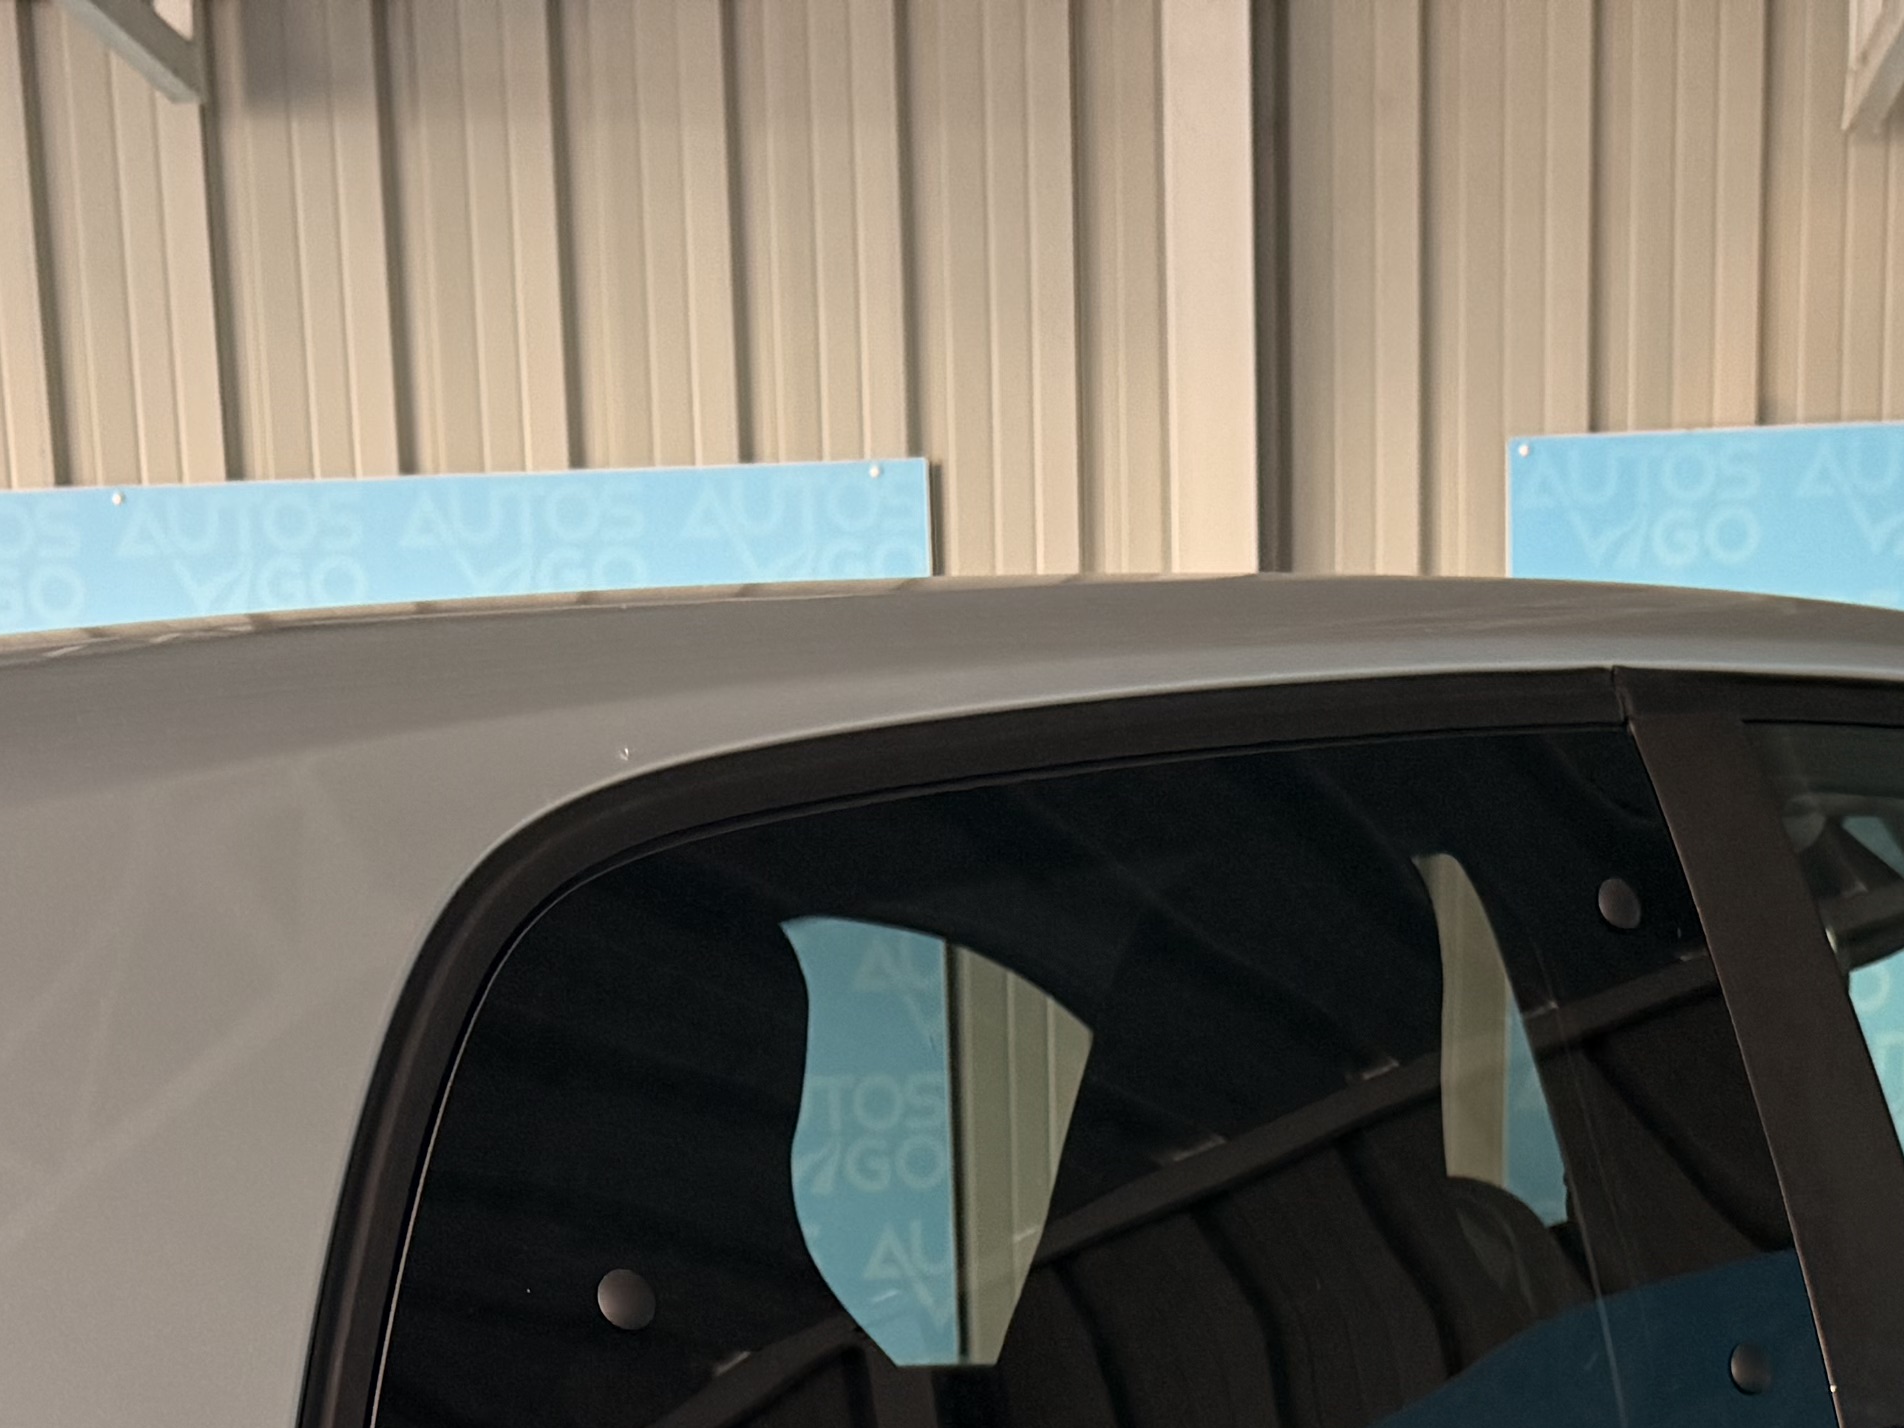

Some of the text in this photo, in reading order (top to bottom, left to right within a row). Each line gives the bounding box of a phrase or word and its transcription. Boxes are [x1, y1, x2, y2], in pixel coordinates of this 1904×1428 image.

[1520, 444, 1762, 509] AUTOS
[116, 492, 362, 557] AUTOS
[398, 478, 646, 547] AUTOS
